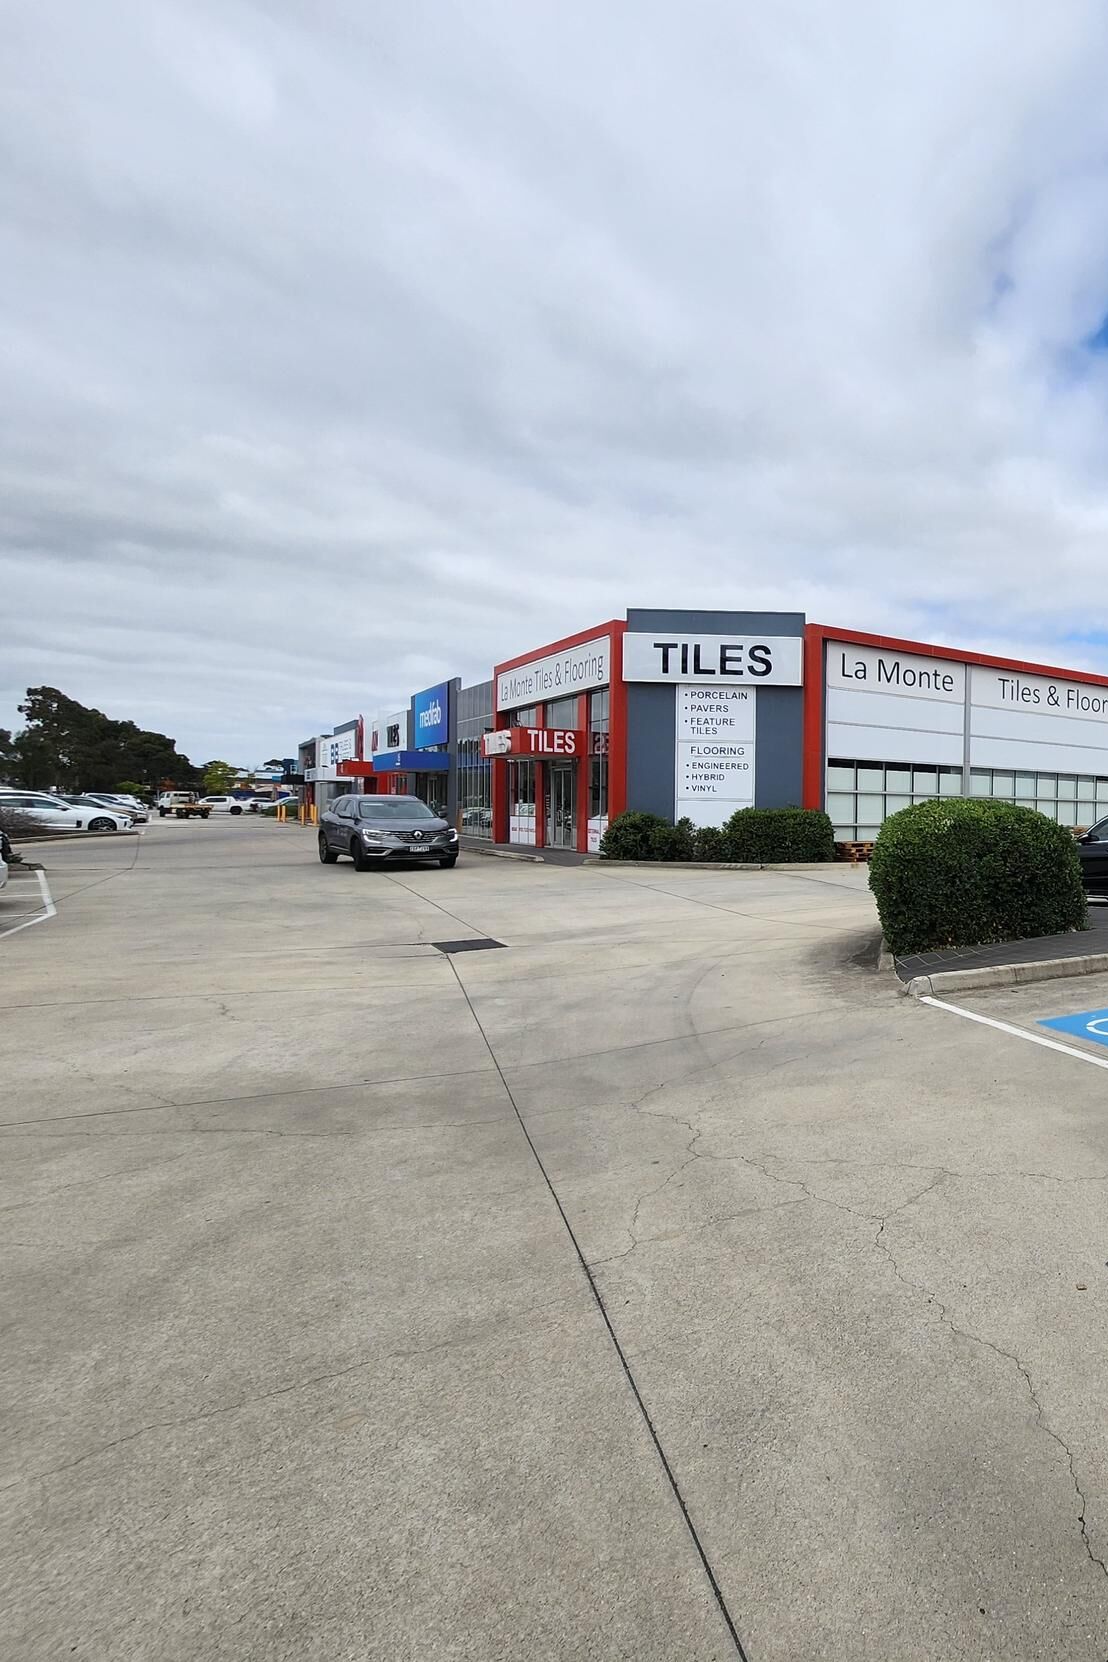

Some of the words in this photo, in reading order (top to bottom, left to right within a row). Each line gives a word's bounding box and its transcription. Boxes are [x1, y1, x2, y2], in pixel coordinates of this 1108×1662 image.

[653, 642, 773, 677] TILES
[840, 652, 867, 680] La
[877, 658, 954, 692] Monte
[501, 682, 508, 701] La
[510, 676, 532, 697] Monte
[535, 667, 552, 693] Tiles
[555, 663, 562, 686] &
[564, 653, 604, 682] Flooring
[690, 691, 748, 700] PORCELAIN
[997, 678, 1041, 704] Tiles
[1046, 685, 1061, 707] &
[690, 705, 729, 713] PAVERS
[419, 699, 442, 729] medifab
[690, 717, 736, 726] FEATURE
[690, 727, 718, 735] TILES
[527, 729, 576, 753] TILES
[690, 746, 745, 756] FLOORING
[691, 762, 749, 771] ENGINEERED
[691, 773, 725, 781] HYBRID
[691, 785, 718, 793] VINYL
